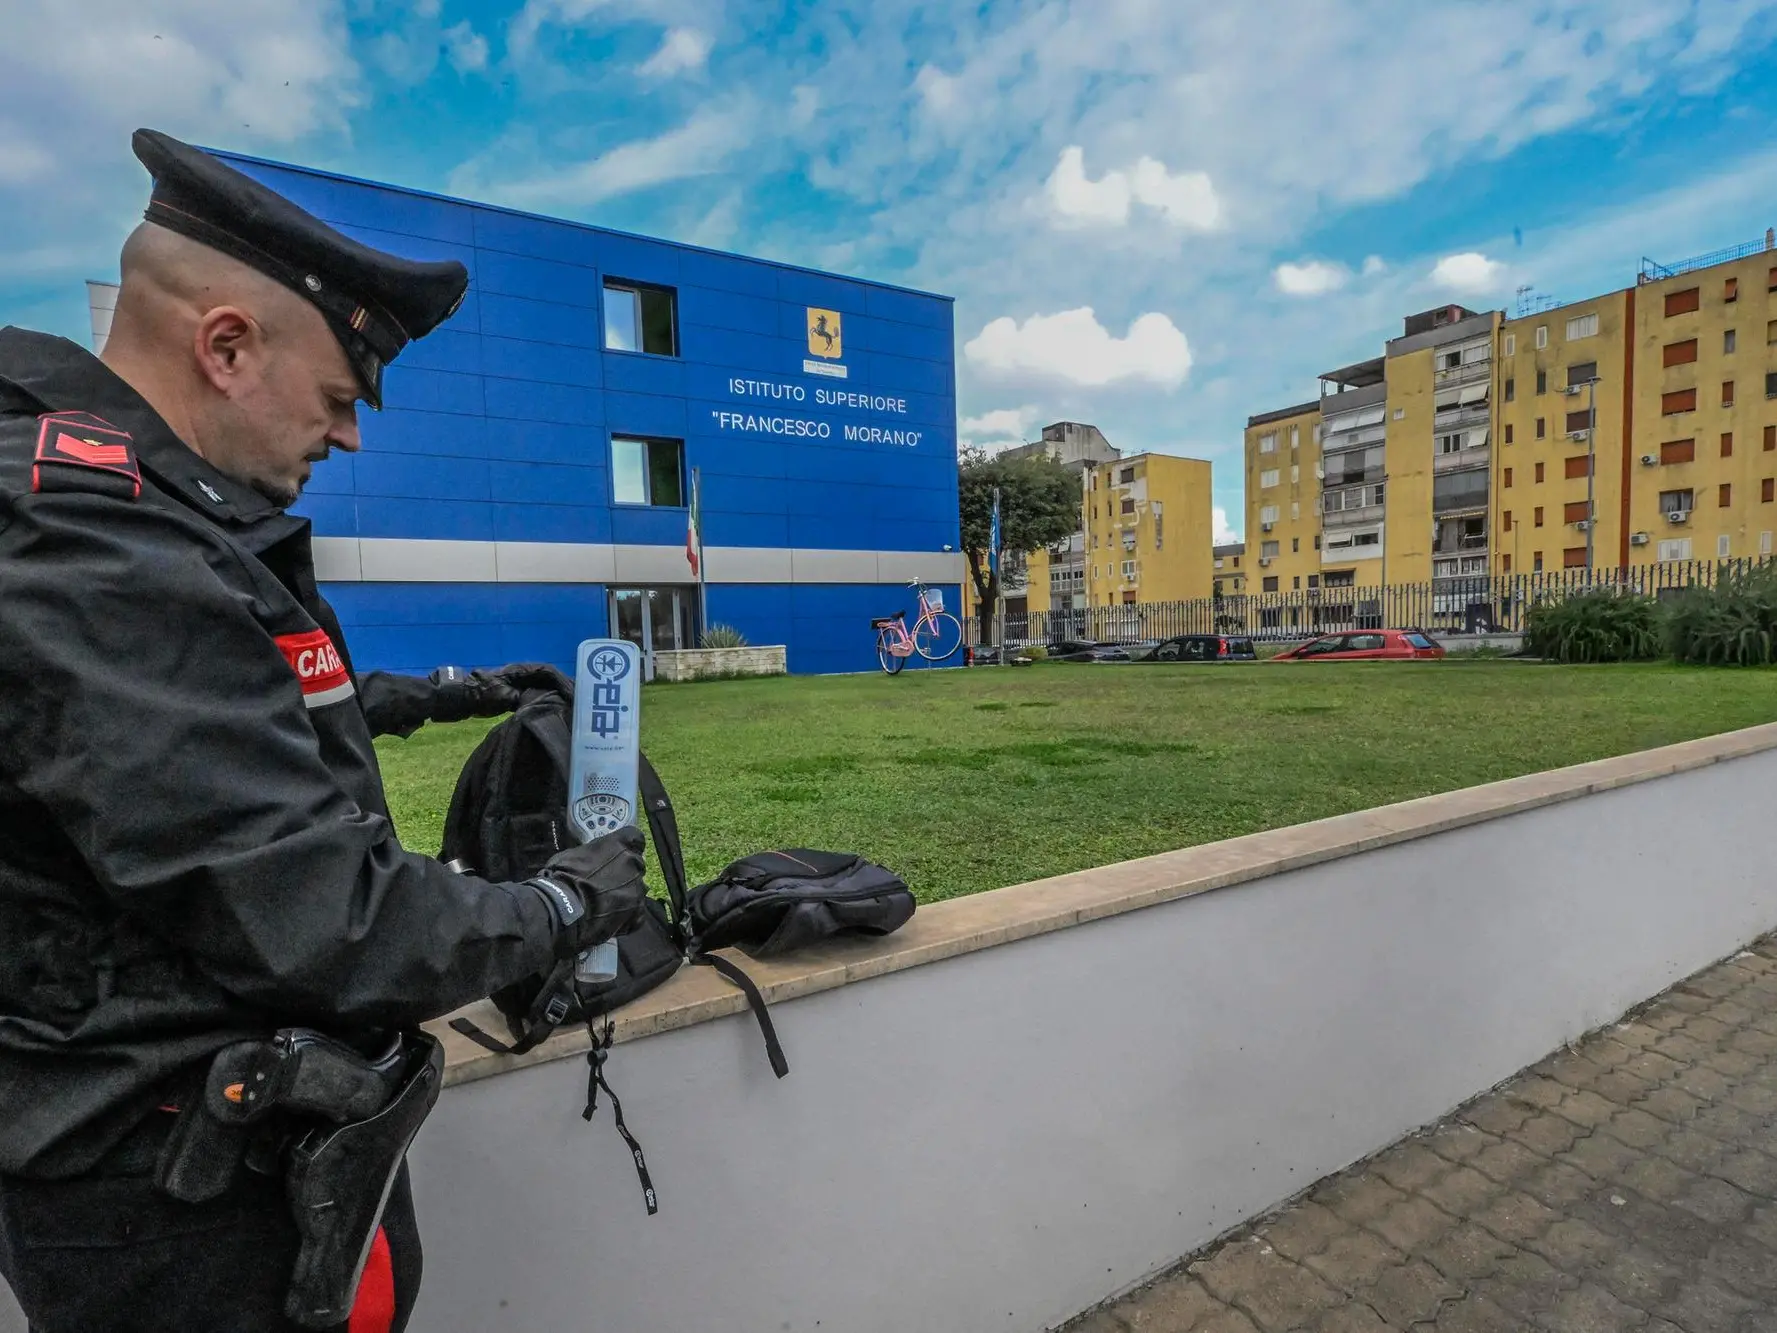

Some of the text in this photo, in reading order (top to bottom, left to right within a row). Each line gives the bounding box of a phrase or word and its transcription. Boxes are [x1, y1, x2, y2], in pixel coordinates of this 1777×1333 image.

[729, 378, 907, 413] ISTITUTO SUPERIORE
[712, 411, 922, 447] "FRANCESCO MORANO"
